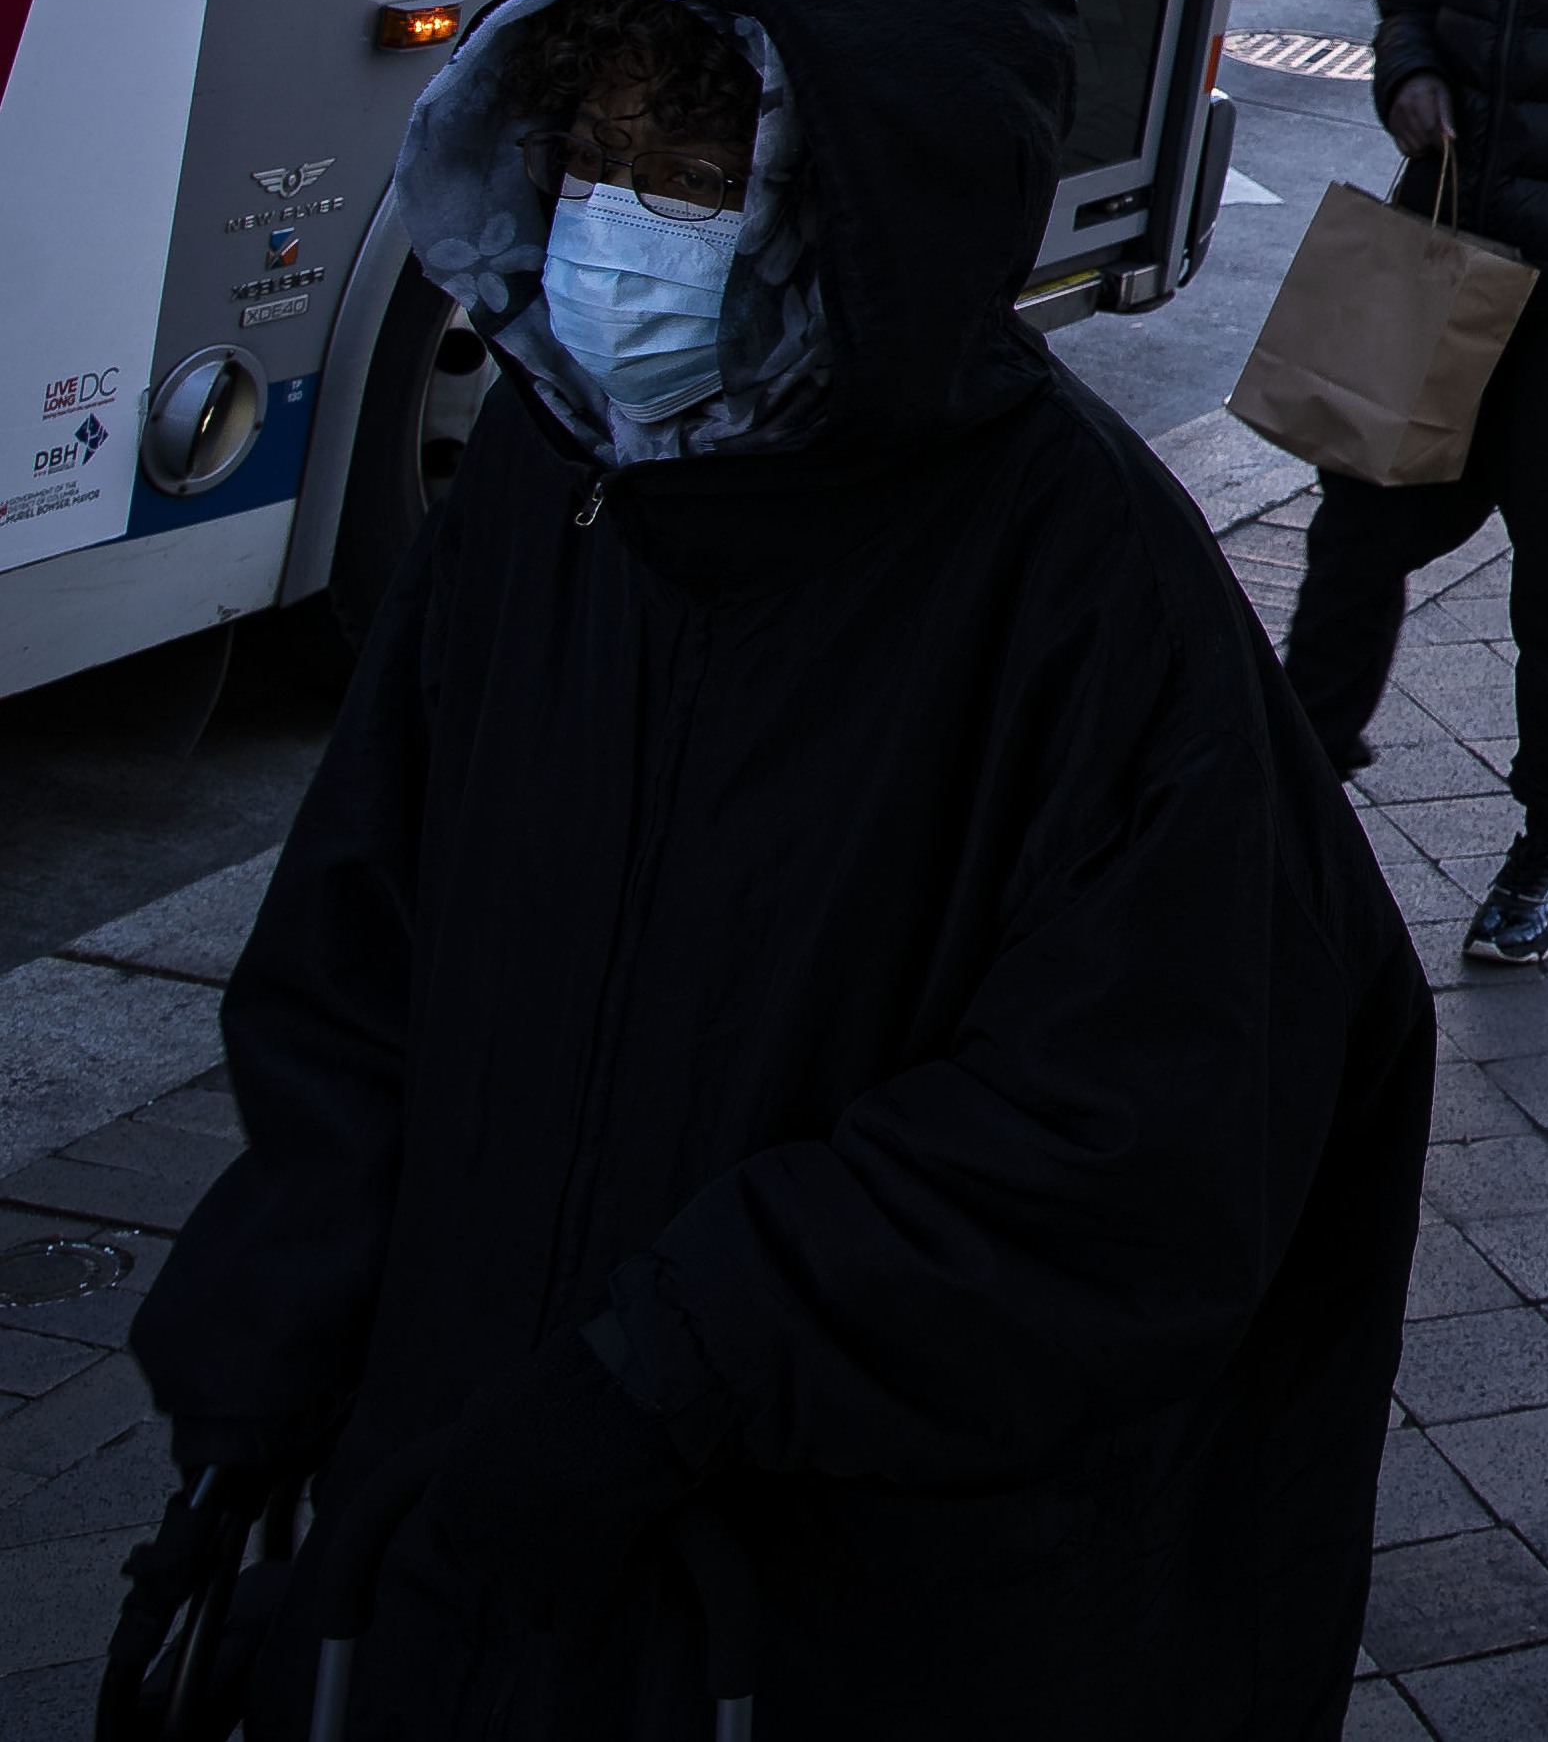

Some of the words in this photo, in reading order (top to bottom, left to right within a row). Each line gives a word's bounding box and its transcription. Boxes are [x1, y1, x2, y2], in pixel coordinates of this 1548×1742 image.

[225, 211, 276, 234] NEW
[280, 196, 344, 221] FLYER
[44, 393, 76, 413] LONG
[79, 367, 119, 403] DC
[46, 376, 79, 399] LIVE
[33, 442, 79, 472] DBH
